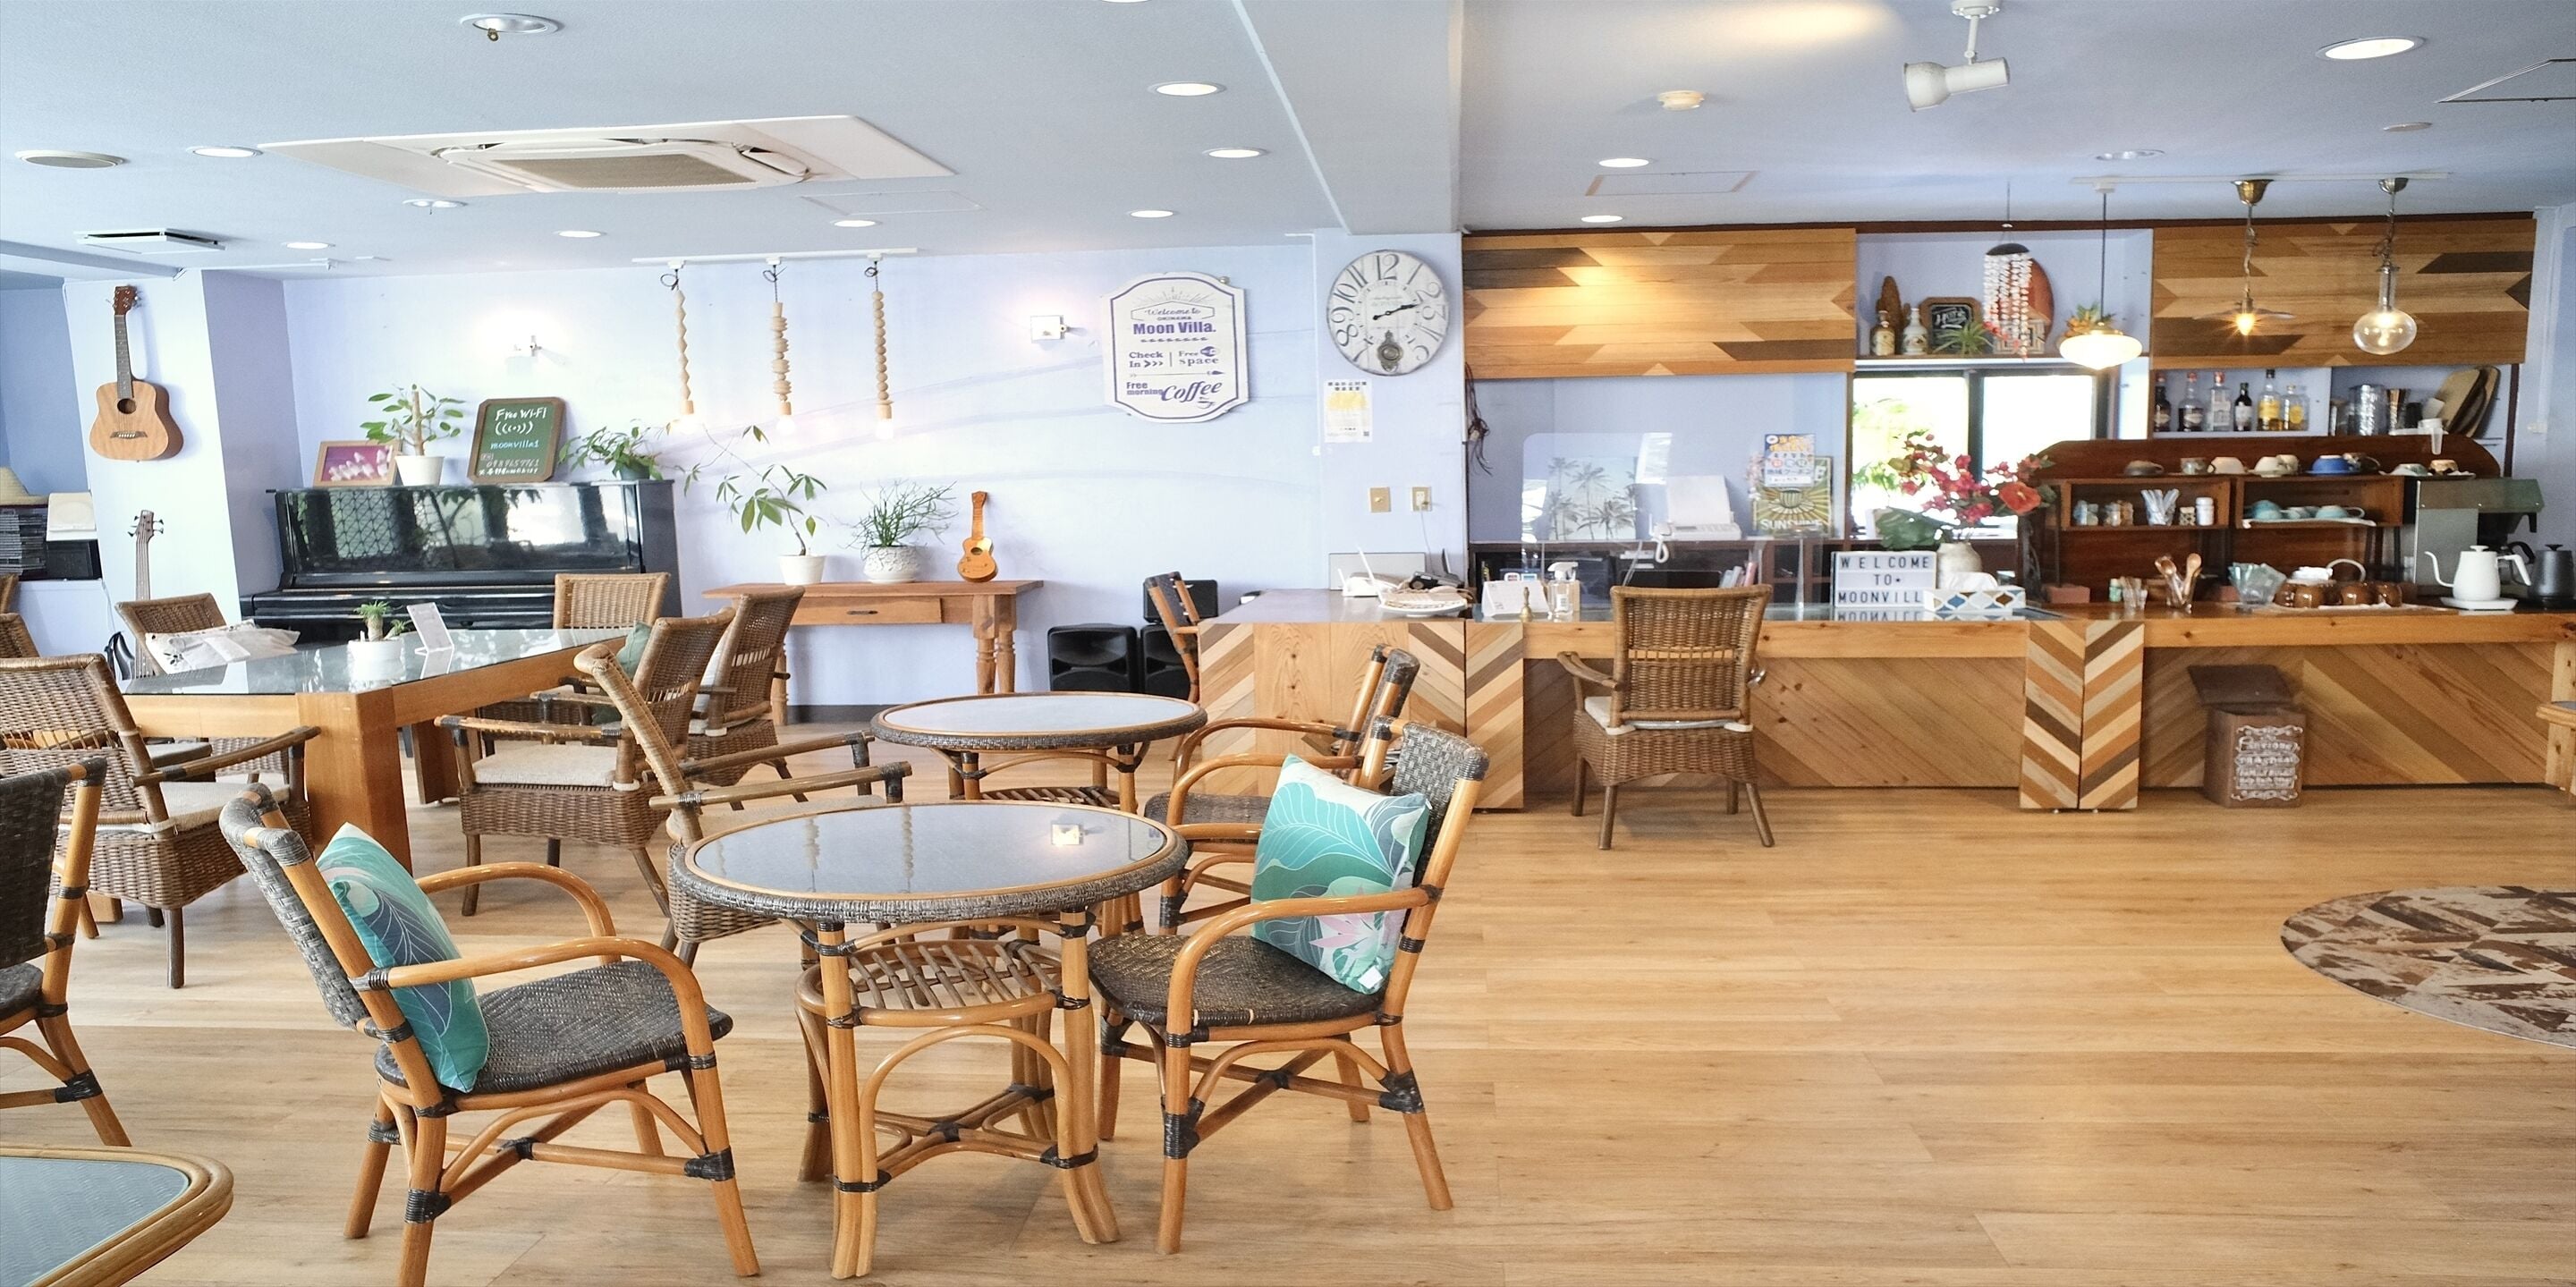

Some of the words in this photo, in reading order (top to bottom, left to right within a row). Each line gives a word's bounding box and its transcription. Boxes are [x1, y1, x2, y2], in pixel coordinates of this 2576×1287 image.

[1376, 253, 1400, 281] 12
[1344, 264, 1368, 288] 11
[1334, 283, 1359, 304] 10
[1416, 281, 1442, 302] 2
[1145, 308, 1190, 316] Welcome
[1191, 307, 1201, 315] to
[1330, 306, 1355, 324] 9
[1422, 304, 1446, 320] 3
[1133, 323, 1175, 334] Moon
[1178, 321, 1217, 334] Villa.
[1335, 324, 1359, 347] 8
[1129, 351, 1164, 359] Check
[1179, 358, 1219, 366] space
[1161, 380, 1223, 403] Coffee
[495, 408, 518, 421] Free
[1841, 556, 1929, 569] WELCOME
[1874, 574, 1892, 586] TO
[1838, 591, 1921, 604] MOONVILL
